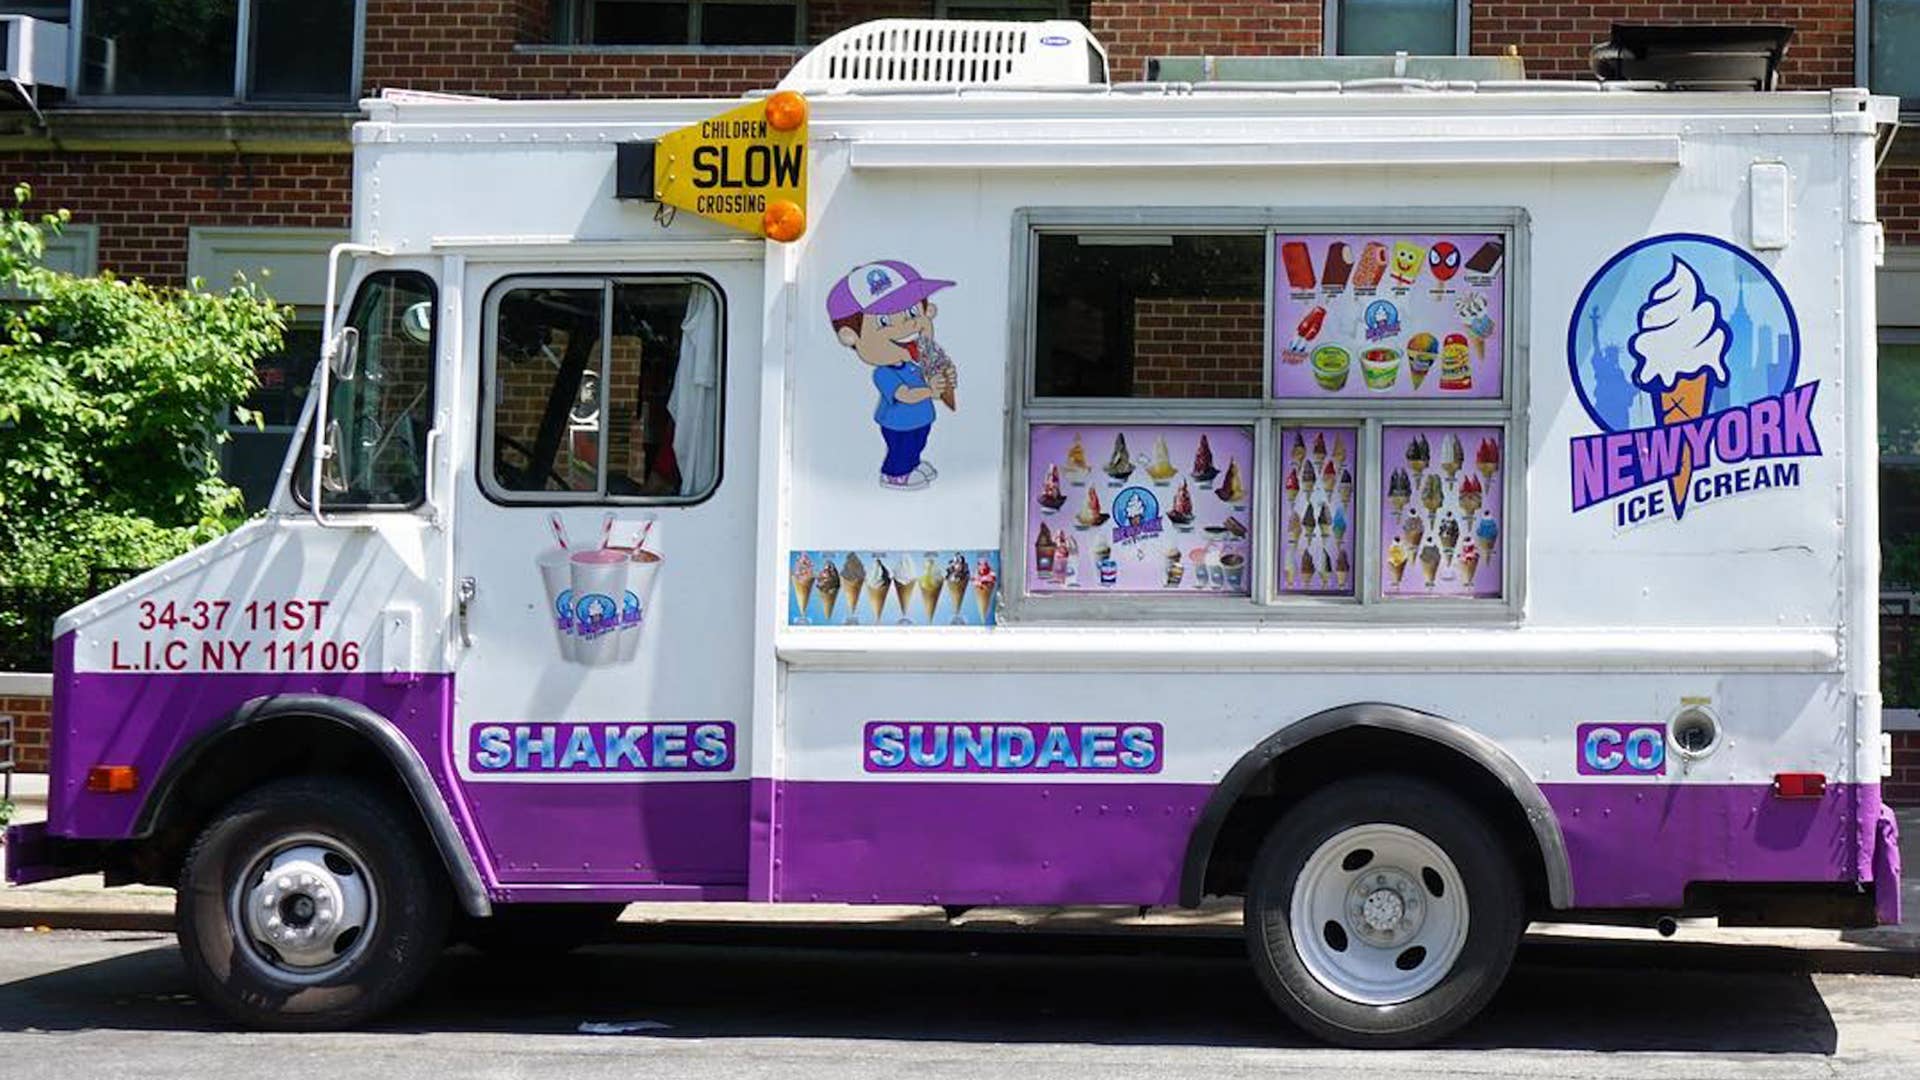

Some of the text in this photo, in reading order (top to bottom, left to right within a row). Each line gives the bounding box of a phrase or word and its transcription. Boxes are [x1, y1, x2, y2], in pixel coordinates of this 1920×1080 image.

[702, 121, 767, 139] CHILDREN
[692, 146, 802, 188] SLOW
[697, 194, 766, 213] CROSSING
[1617, 463, 1799, 526] ICE CREAM
[138, 601, 330, 630] 34-37 11ST
[111, 641, 360, 670] L.I.C NY 11106
[476, 725, 728, 768] SHAKES
[870, 725, 1157, 767] SUNDAES
[1585, 727, 1665, 770] CO
